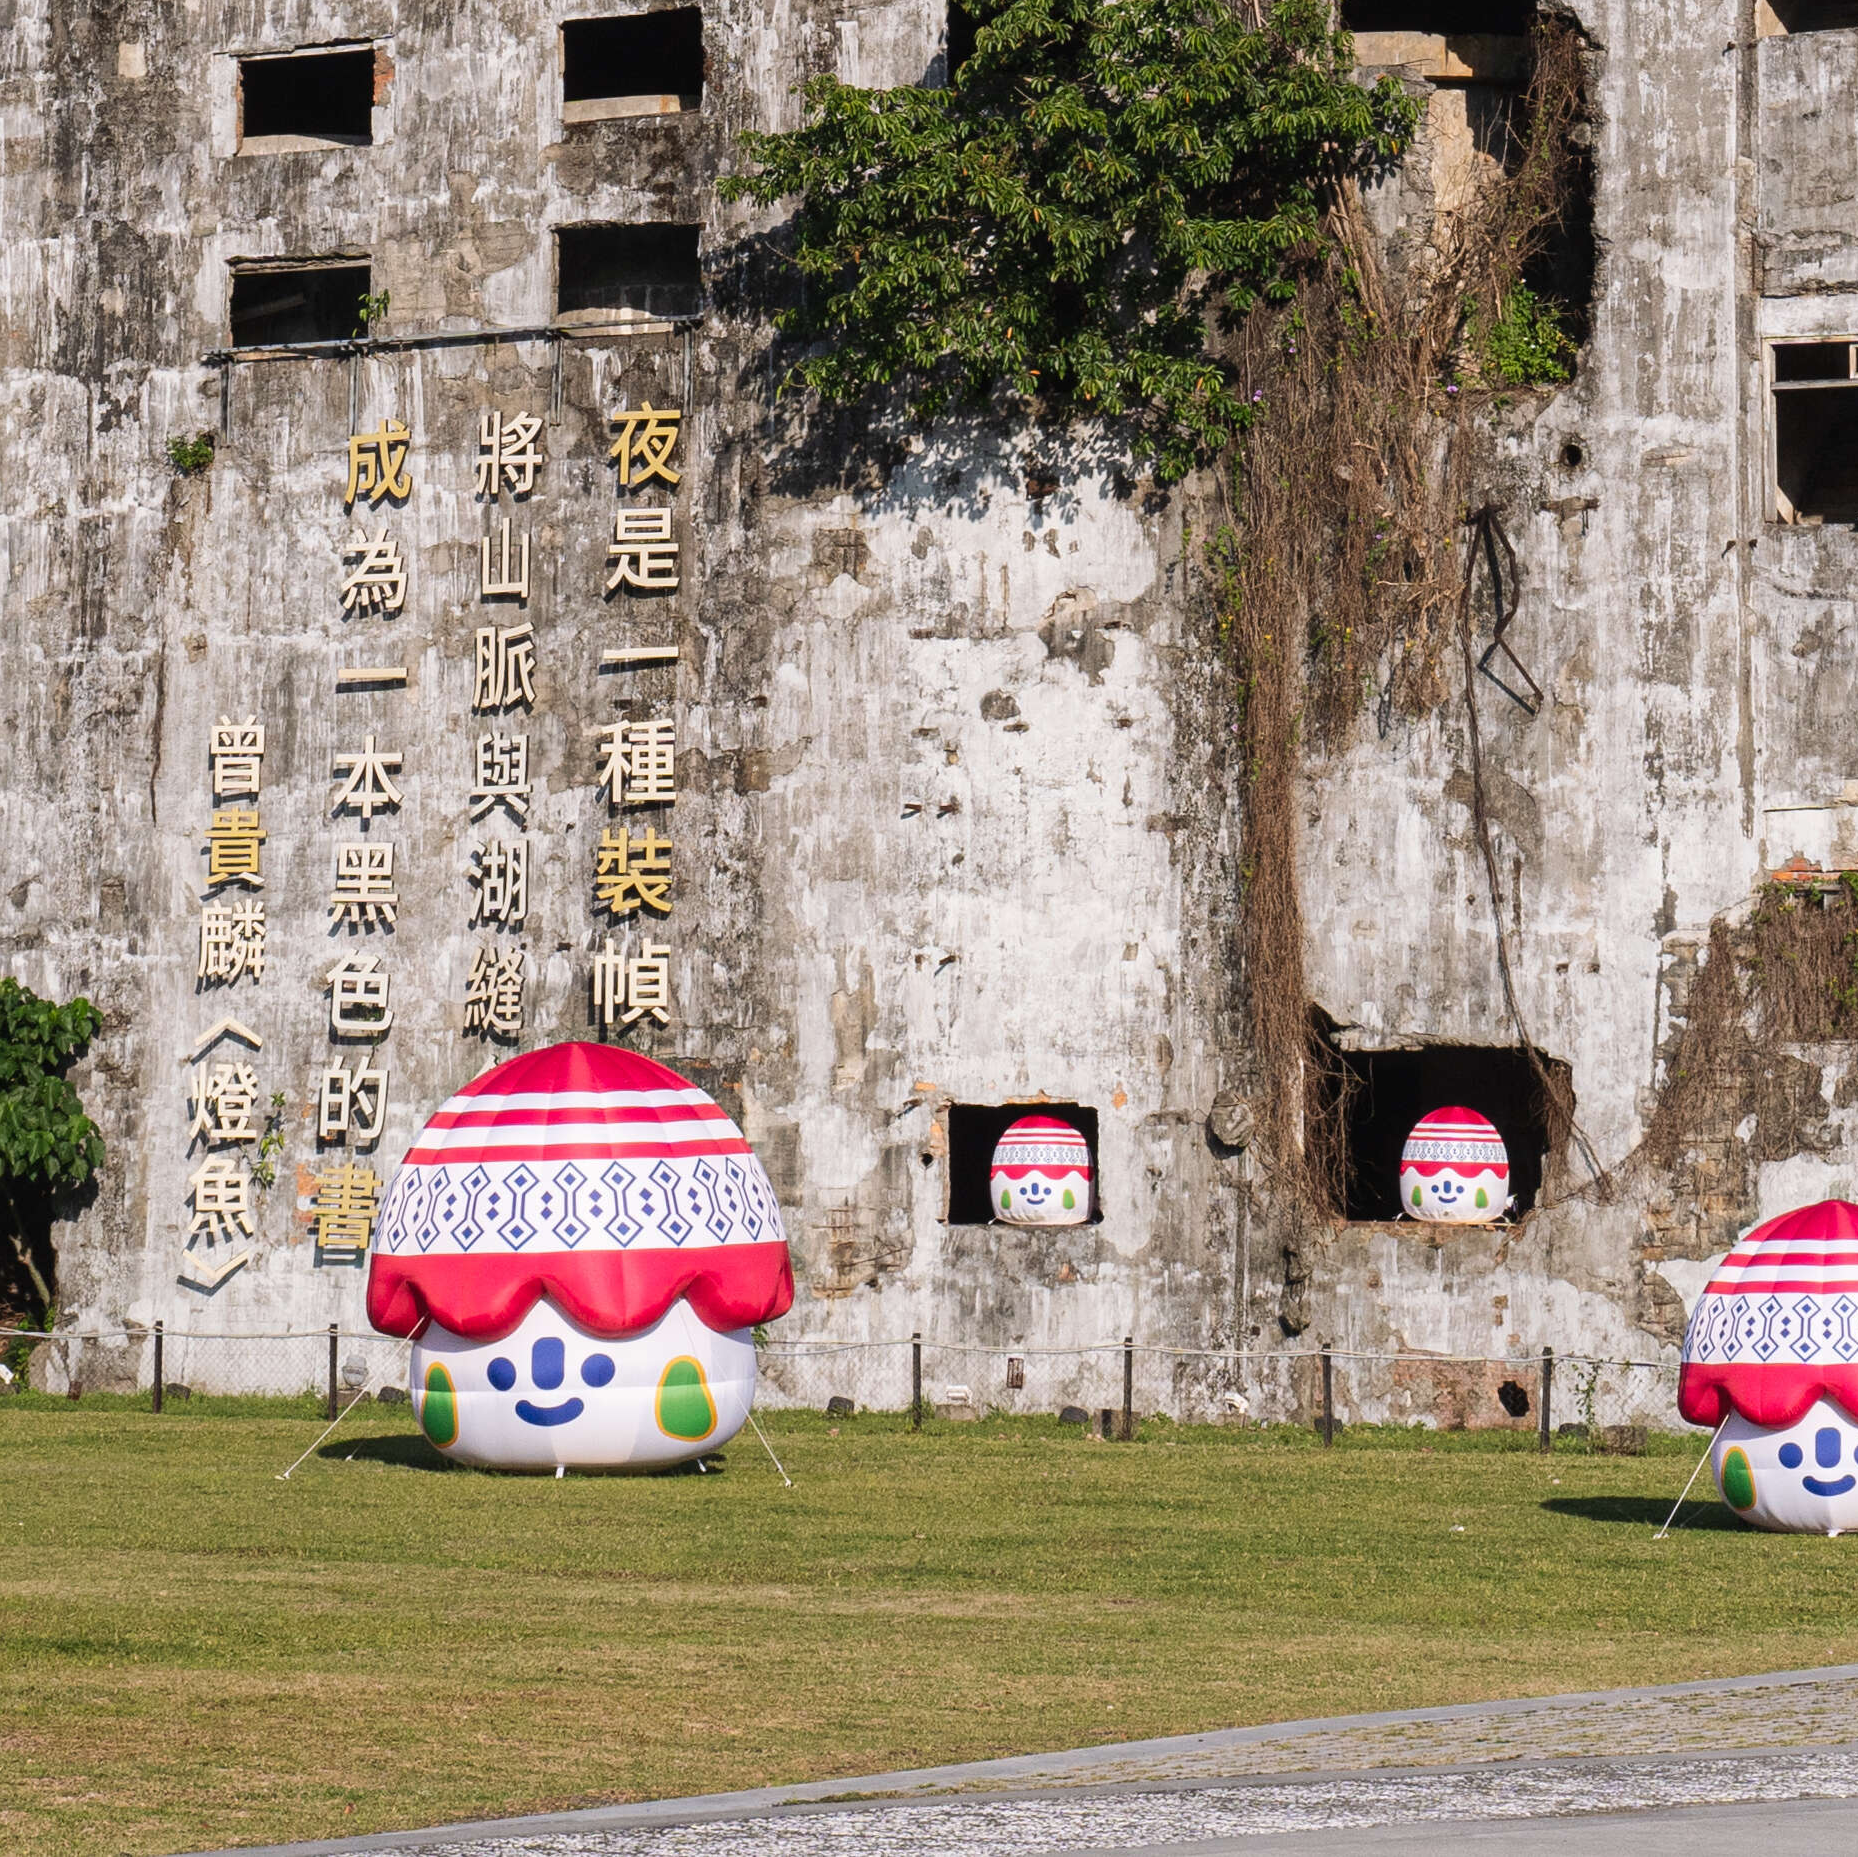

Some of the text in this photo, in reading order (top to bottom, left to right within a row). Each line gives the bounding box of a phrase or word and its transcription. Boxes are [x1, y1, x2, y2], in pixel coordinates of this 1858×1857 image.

[315, 419, 412, 1249] 成為一本黑色的書
[463, 411, 544, 1080] 將山脈與湖縫
[594, 401, 683, 1025] 夜是一種裝幀
